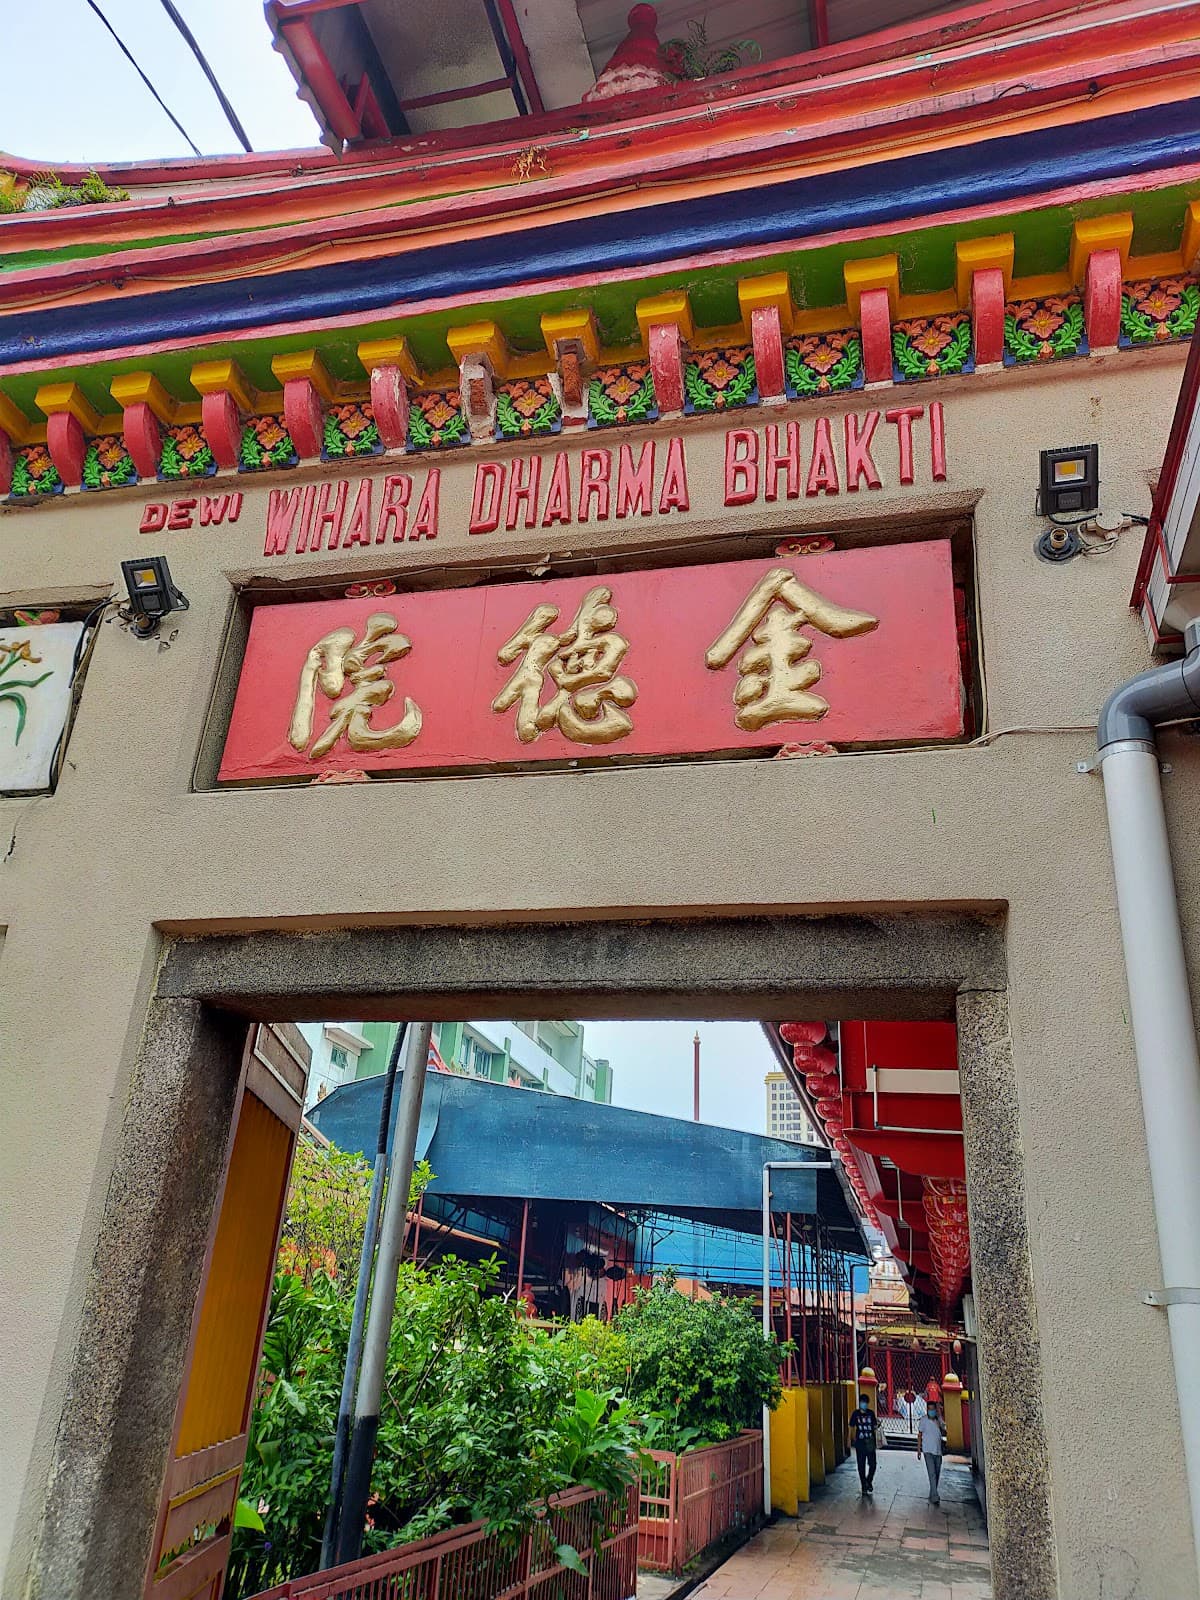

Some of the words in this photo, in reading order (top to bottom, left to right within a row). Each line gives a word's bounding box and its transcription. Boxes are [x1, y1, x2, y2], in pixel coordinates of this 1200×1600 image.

[139, 492, 243, 533] DEWI
[263, 468, 441, 556] WIHARA
[469, 437, 690, 535] DHARMA
[724, 402, 947, 507] BHAKTI
